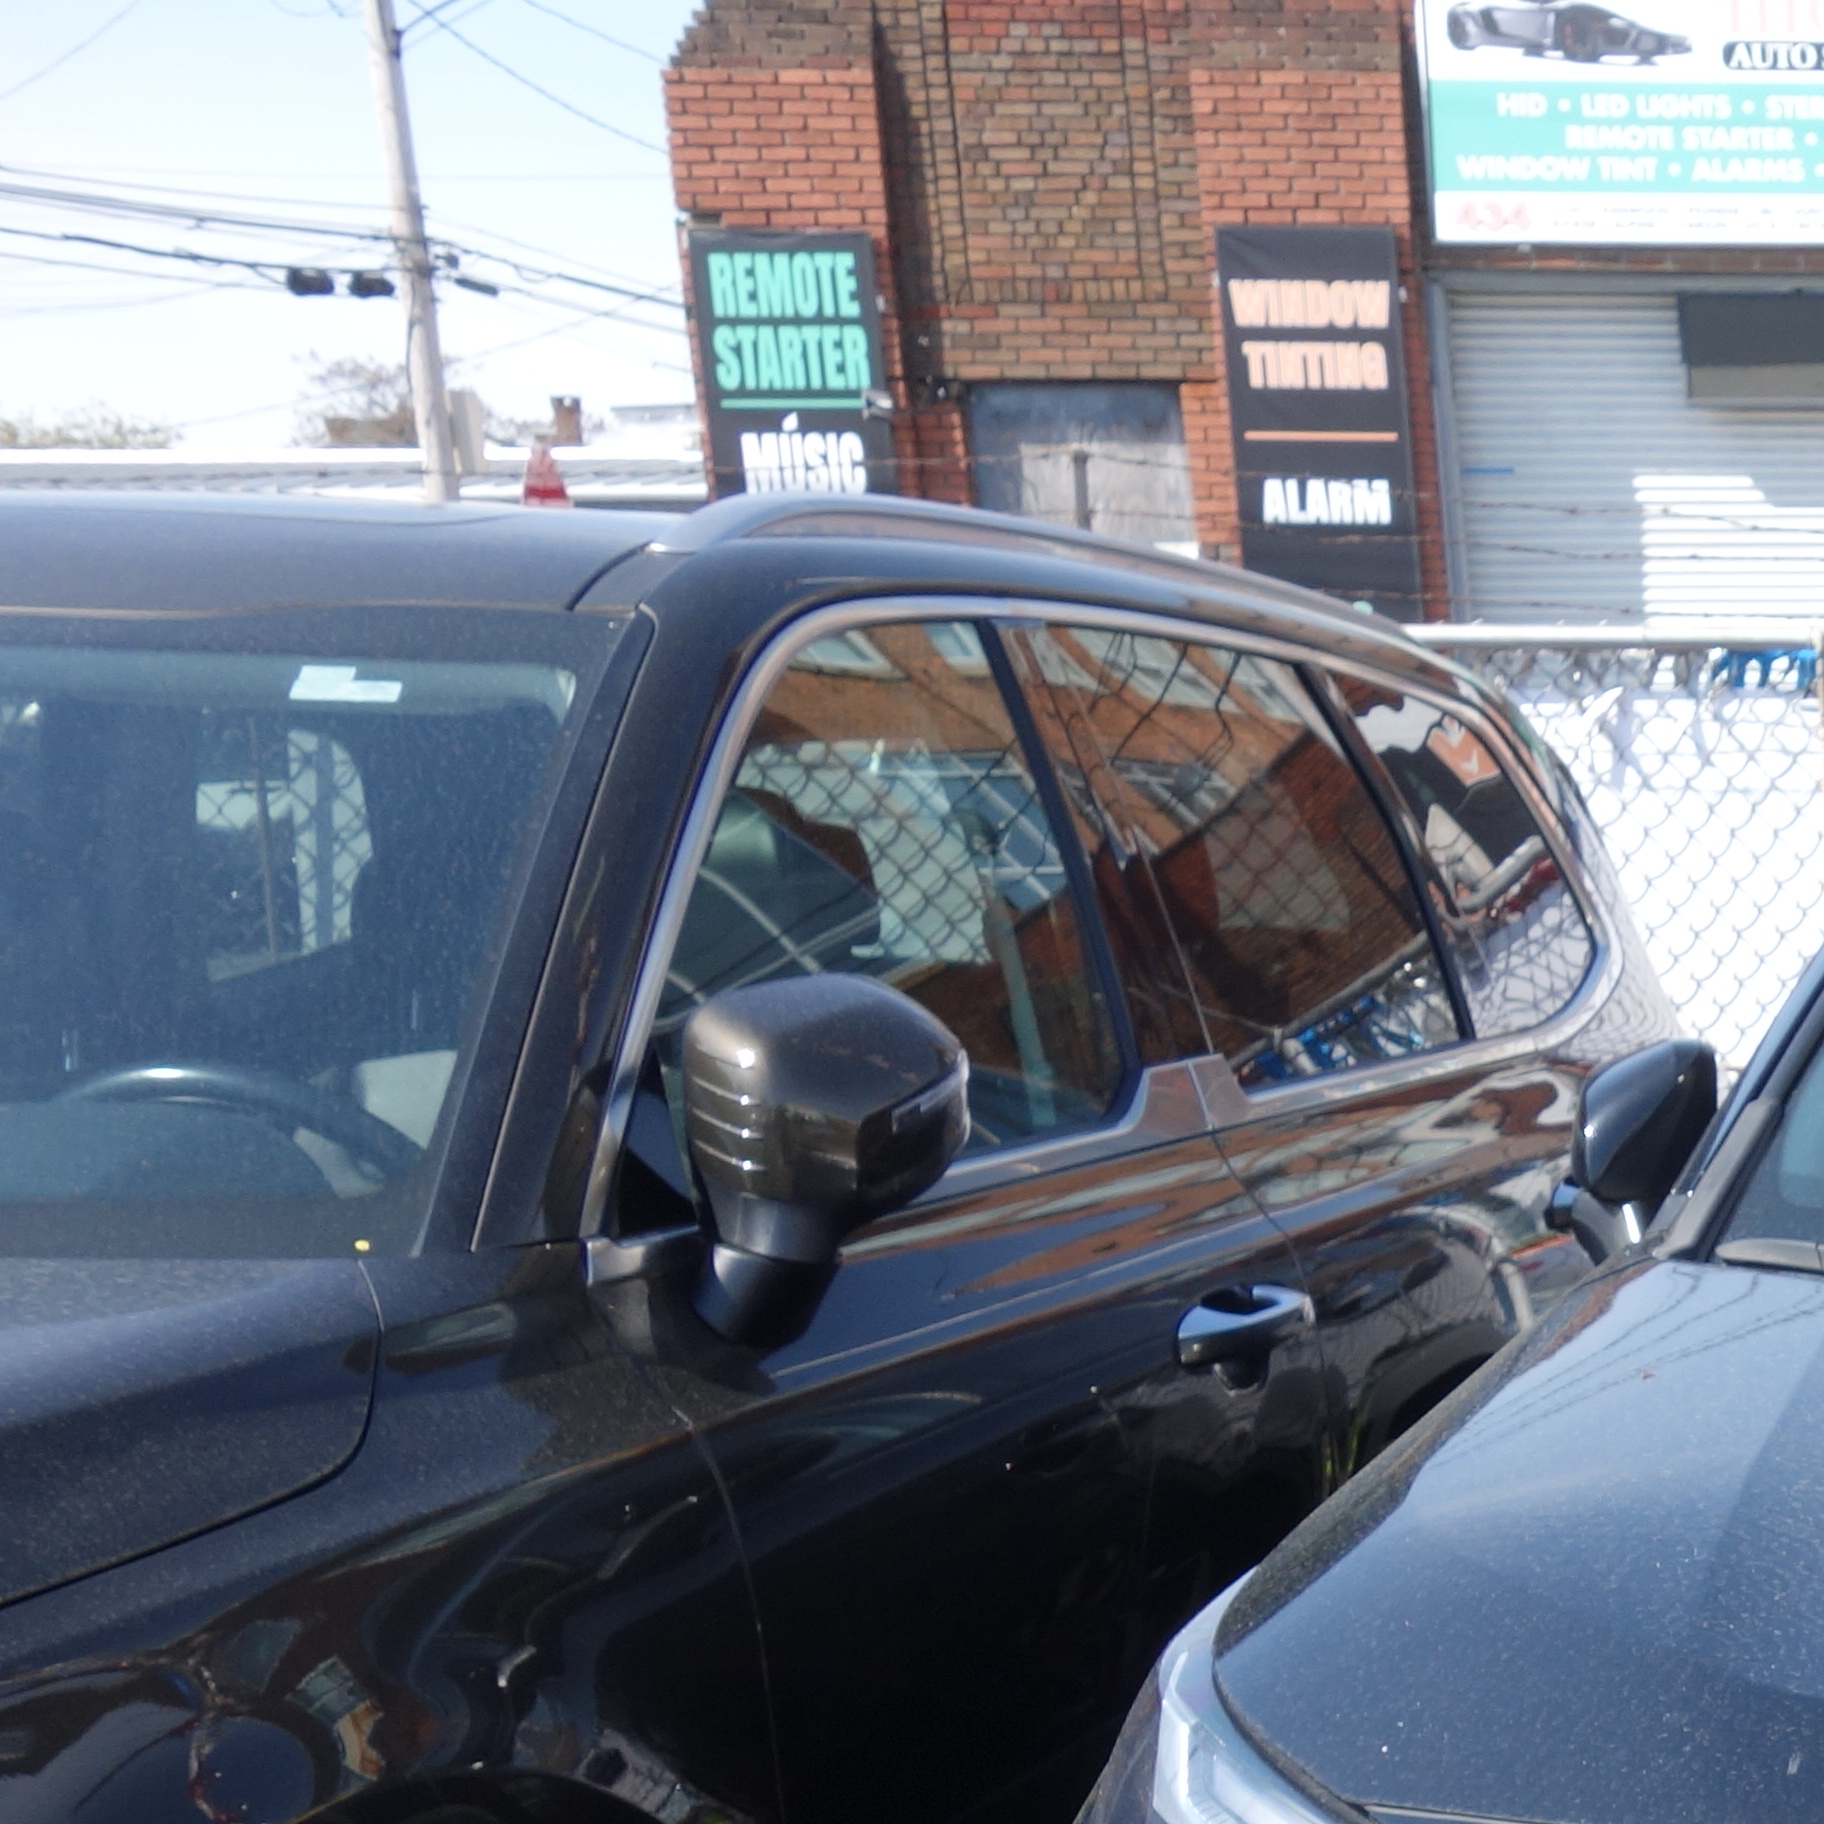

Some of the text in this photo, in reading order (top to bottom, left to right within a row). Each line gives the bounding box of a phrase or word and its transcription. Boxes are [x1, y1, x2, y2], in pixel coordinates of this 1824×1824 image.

[1729, 42, 1817, 69] AUTO
[1496, 92, 1548, 118] HID
[1580, 93, 1629, 118] LED
[1635, 94, 1733, 119] LIGHTS
[1564, 124, 1675, 150] REMOTE
[1681, 125, 1795, 151] STARTER
[1456, 154, 1591, 180] WINDOW
[1597, 156, 1659, 181] TINT
[1691, 157, 1805, 182] ALARMS
[1457, 202, 1531, 232] 434
[707, 252, 861, 319] REMOTE
[1228, 279, 1390, 329] WINDOW
[713, 324, 872, 390] STARTER
[1241, 340, 1389, 390] TINTING
[1262, 478, 1392, 524] ALARM
